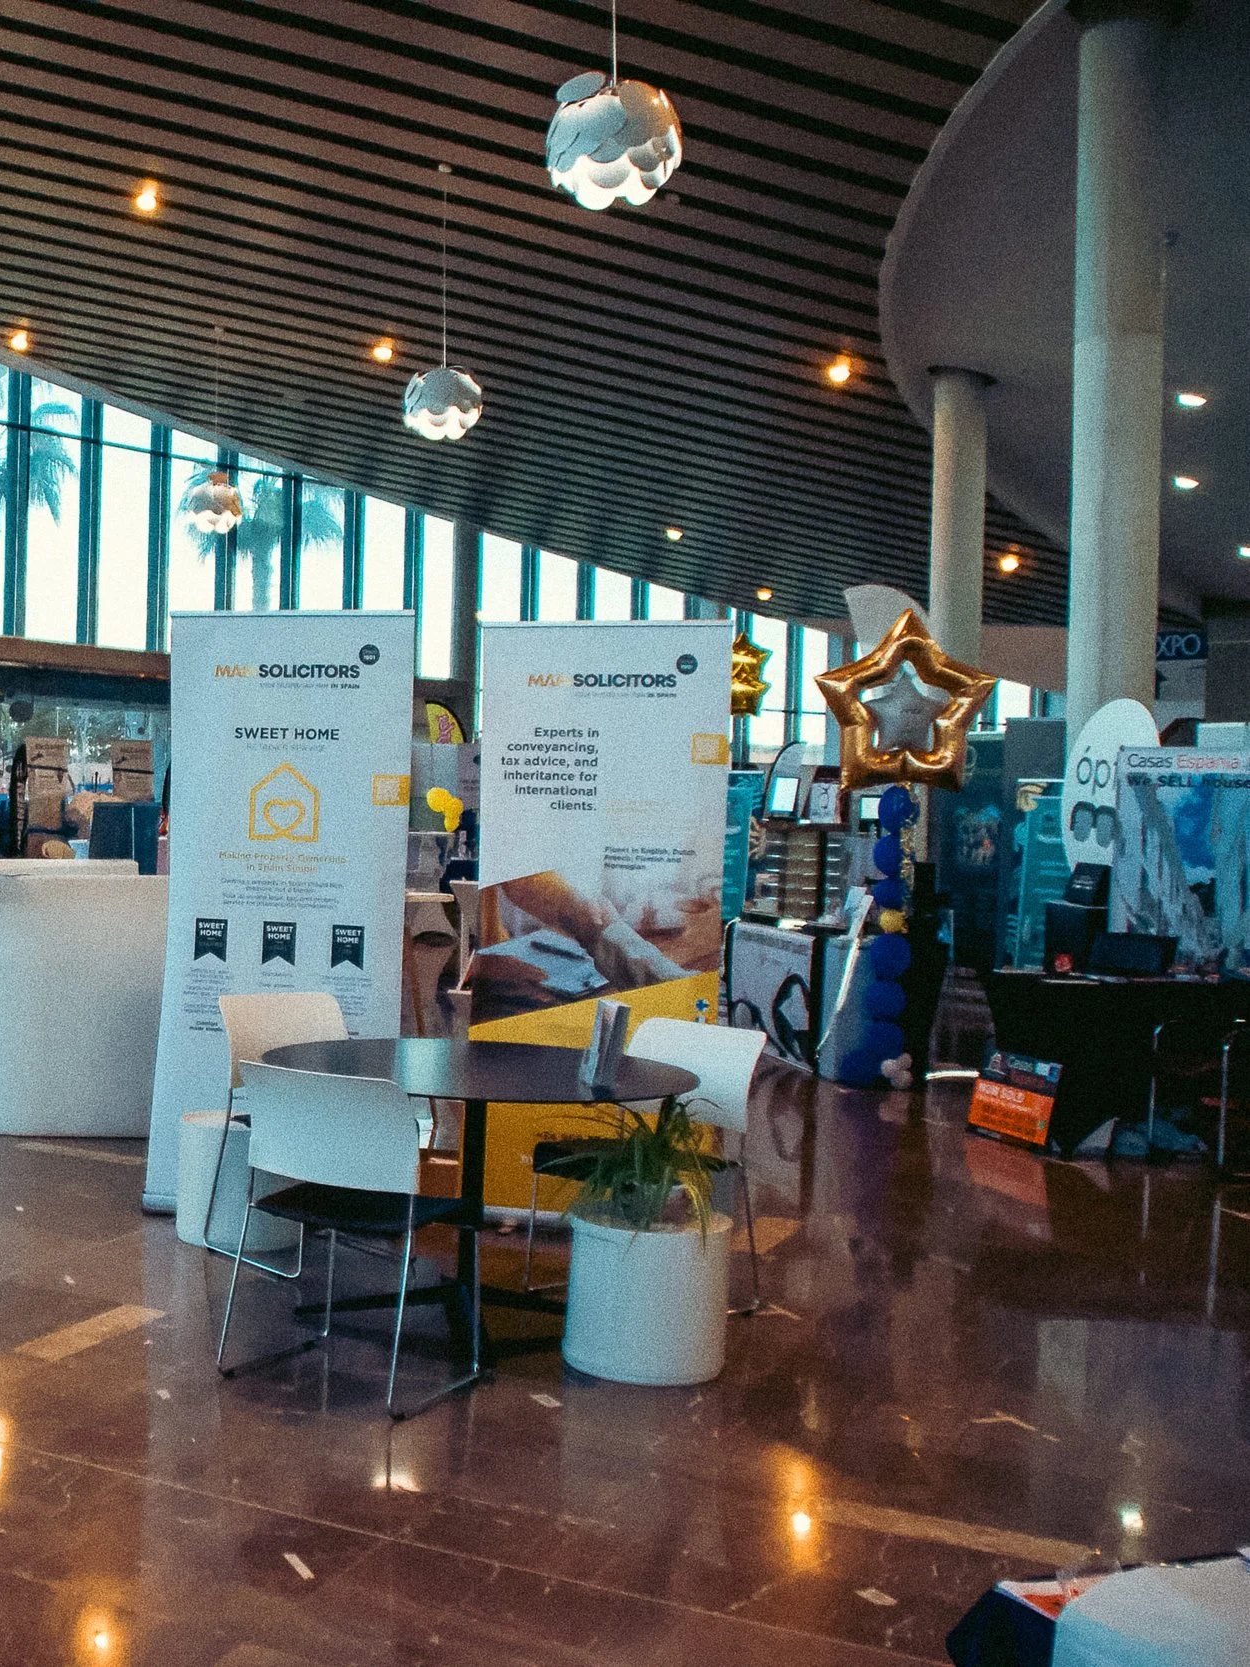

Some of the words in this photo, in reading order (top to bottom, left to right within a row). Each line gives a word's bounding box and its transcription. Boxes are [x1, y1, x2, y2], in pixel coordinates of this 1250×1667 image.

[1155, 633, 1201, 658] XPO
[259, 664, 361, 679] SOLICITORS
[573, 673, 677, 688] SOLICITORS
[234, 727, 289, 740] SWEET
[294, 728, 340, 741] HOME
[534, 727, 583, 739] Experts
[587, 727, 599, 738] in
[507, 742, 599, 755] conveyancing,
[501, 756, 520, 766] tax
[524, 756, 570, 768] advice,
[574, 757, 598, 768] and
[1127, 753, 1173, 769] Casas
[504, 770, 575, 781] inheritance
[579, 771, 598, 782] for
[515, 785, 598, 797] international
[550, 800, 597, 811] clients.
[198, 922, 225, 930] SWEET
[266, 925, 294, 933] SWEET
[335, 928, 362, 936] SWEET
[200, 929, 222, 937] HOME
[267, 932, 291, 940] HOME
[336, 936, 359, 944] HOME
